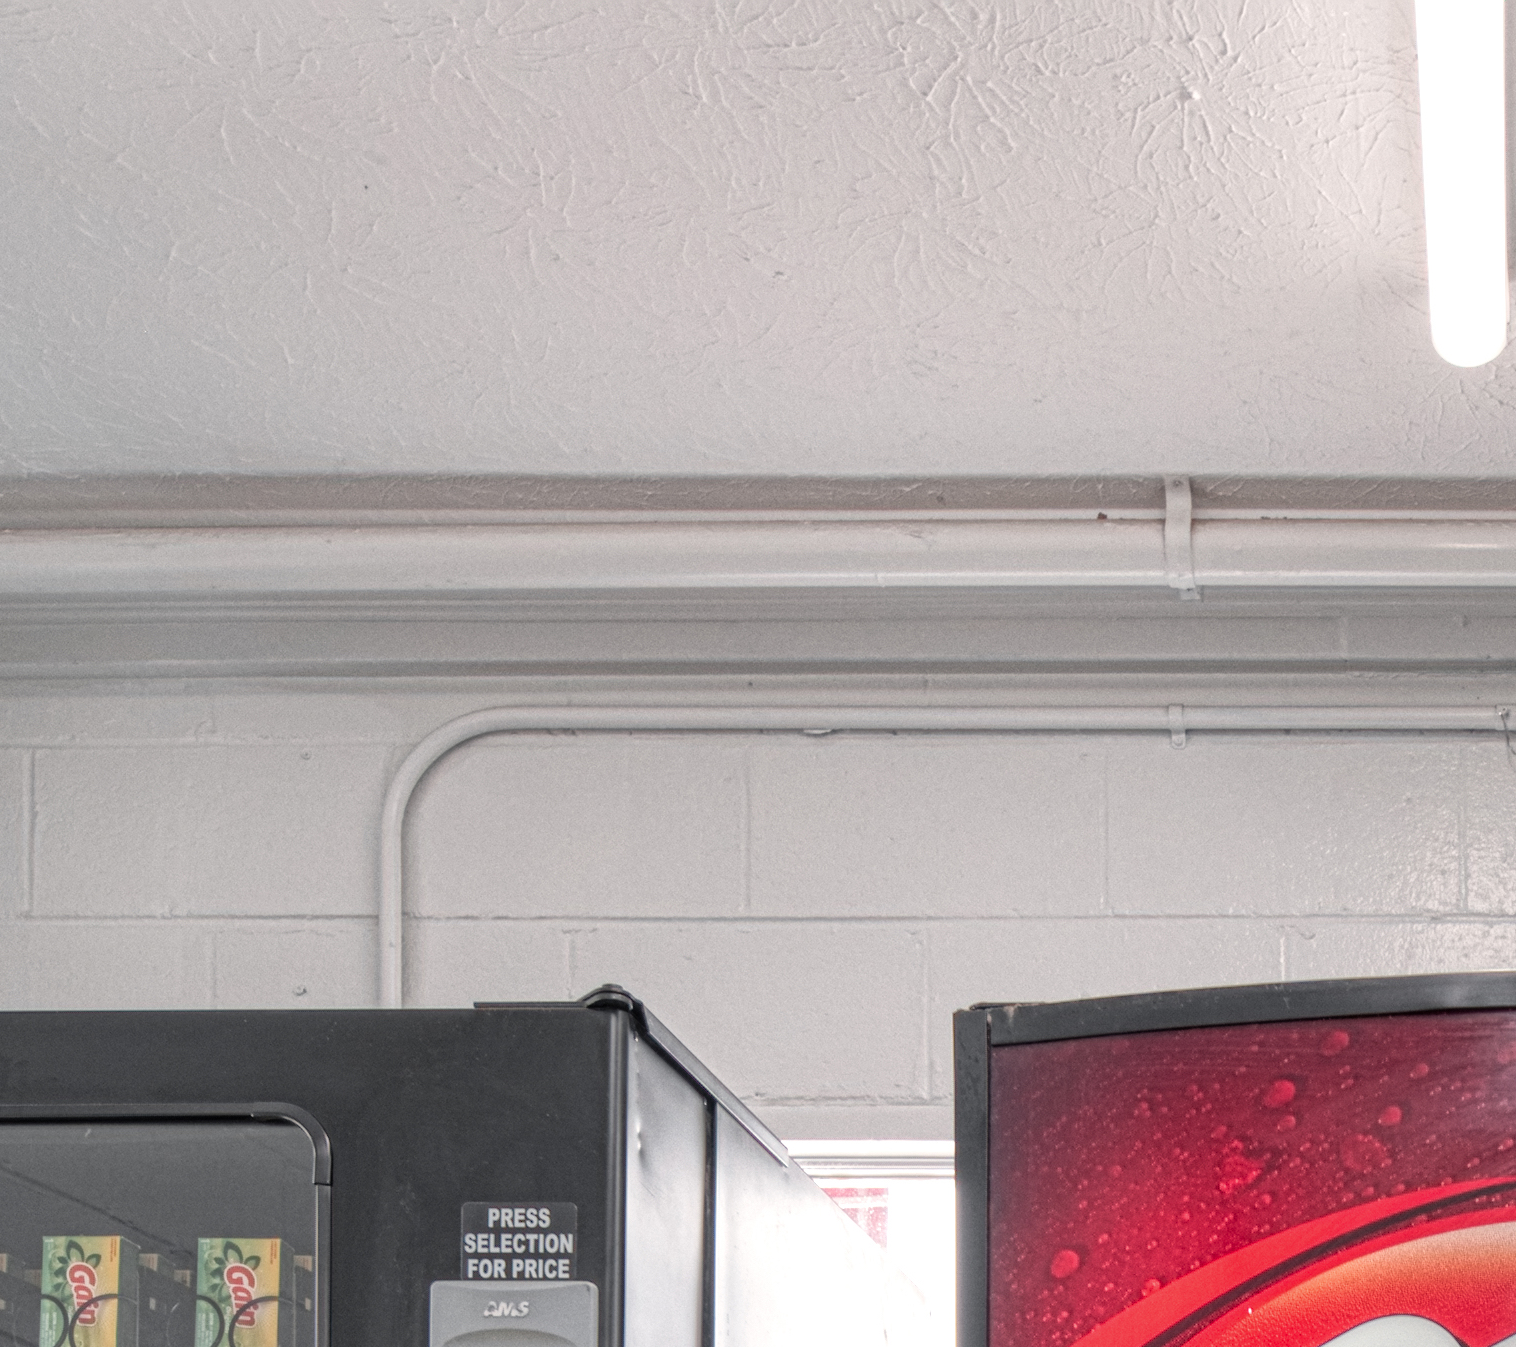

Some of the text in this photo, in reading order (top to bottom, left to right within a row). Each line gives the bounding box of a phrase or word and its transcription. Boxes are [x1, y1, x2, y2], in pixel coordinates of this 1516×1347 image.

[488, 1208, 551, 1228] PRESS
[464, 1233, 574, 1254] SELECTION
[467, 1258, 570, 1279] FOR PRICE
[66, 1261, 100, 1327] Gain
[224, 1263, 259, 1328] Gain
